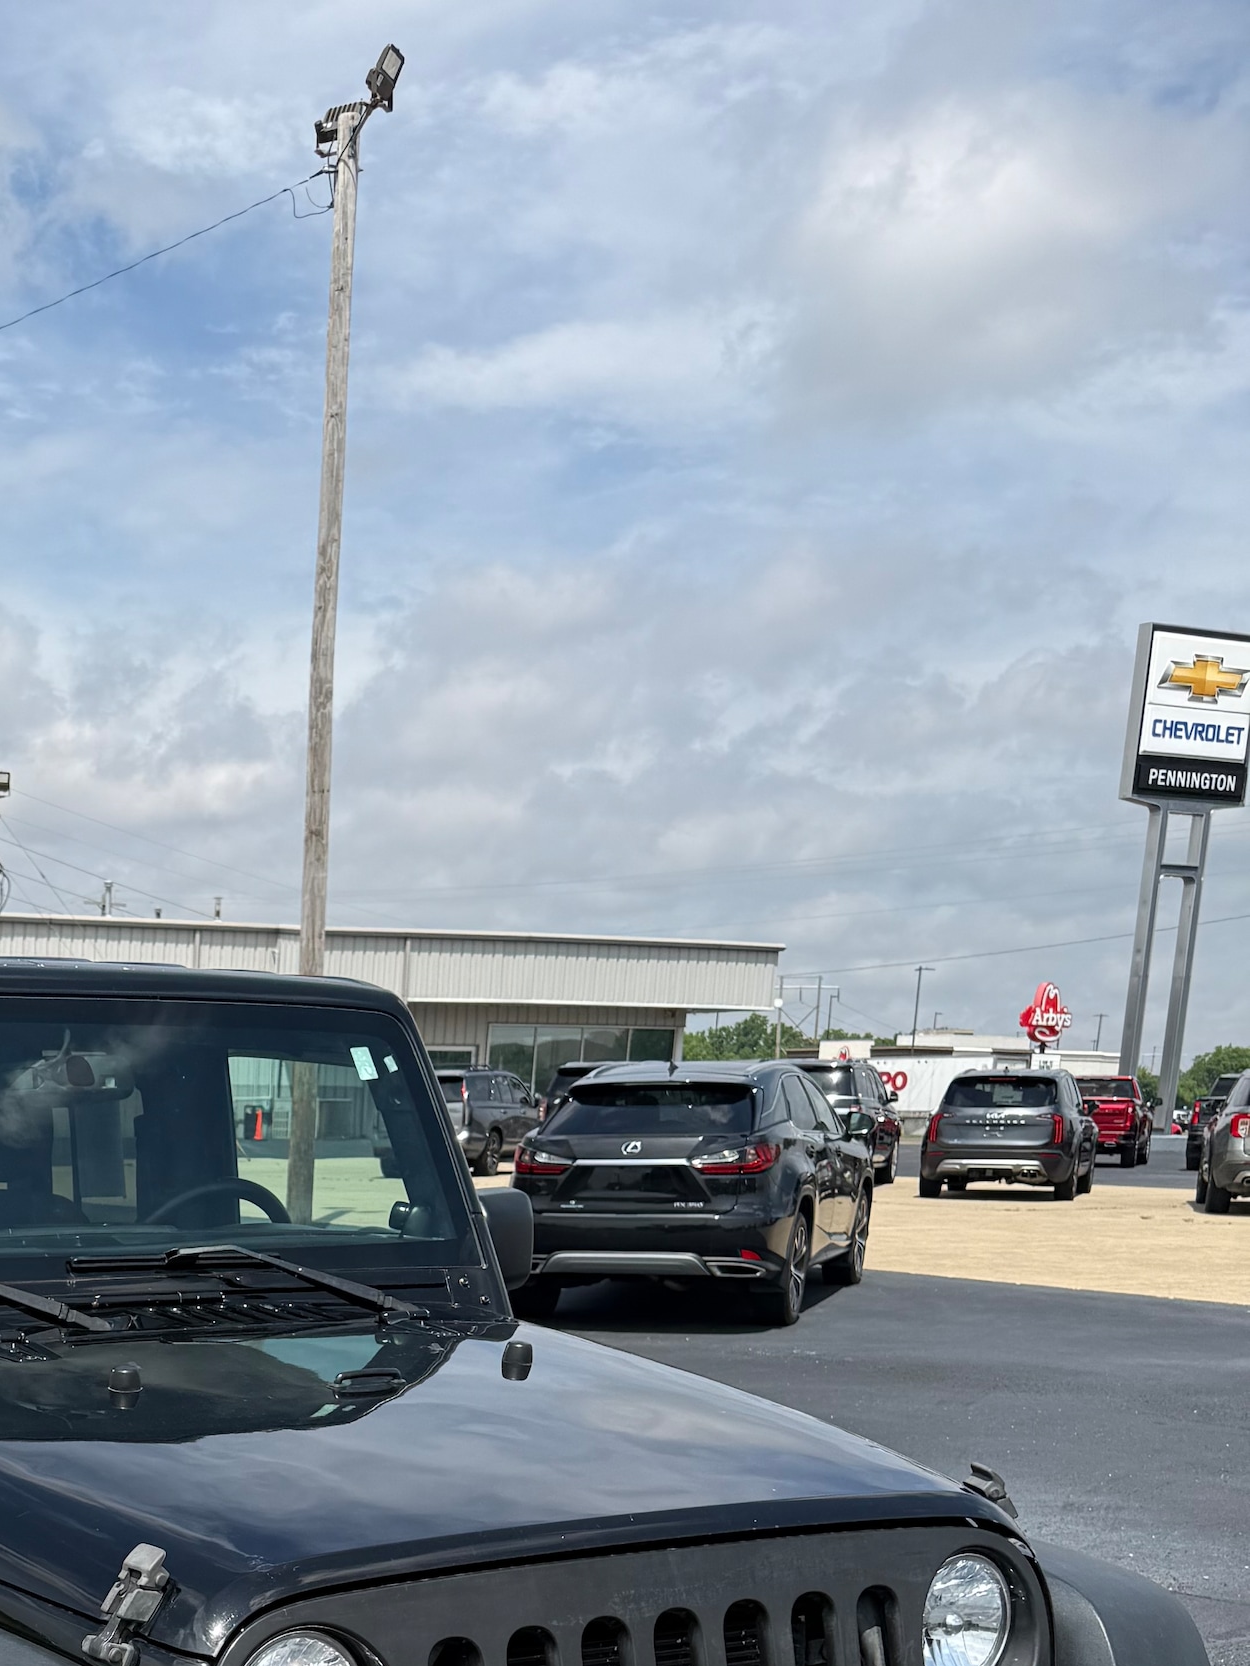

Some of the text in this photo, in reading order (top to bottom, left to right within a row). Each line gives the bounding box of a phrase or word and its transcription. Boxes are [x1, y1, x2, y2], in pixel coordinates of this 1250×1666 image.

[1151, 718, 1245, 745] CHEVROLET
[1147, 767, 1237, 793] PENNINGTON
[1031, 1006, 1072, 1031] Arby's
